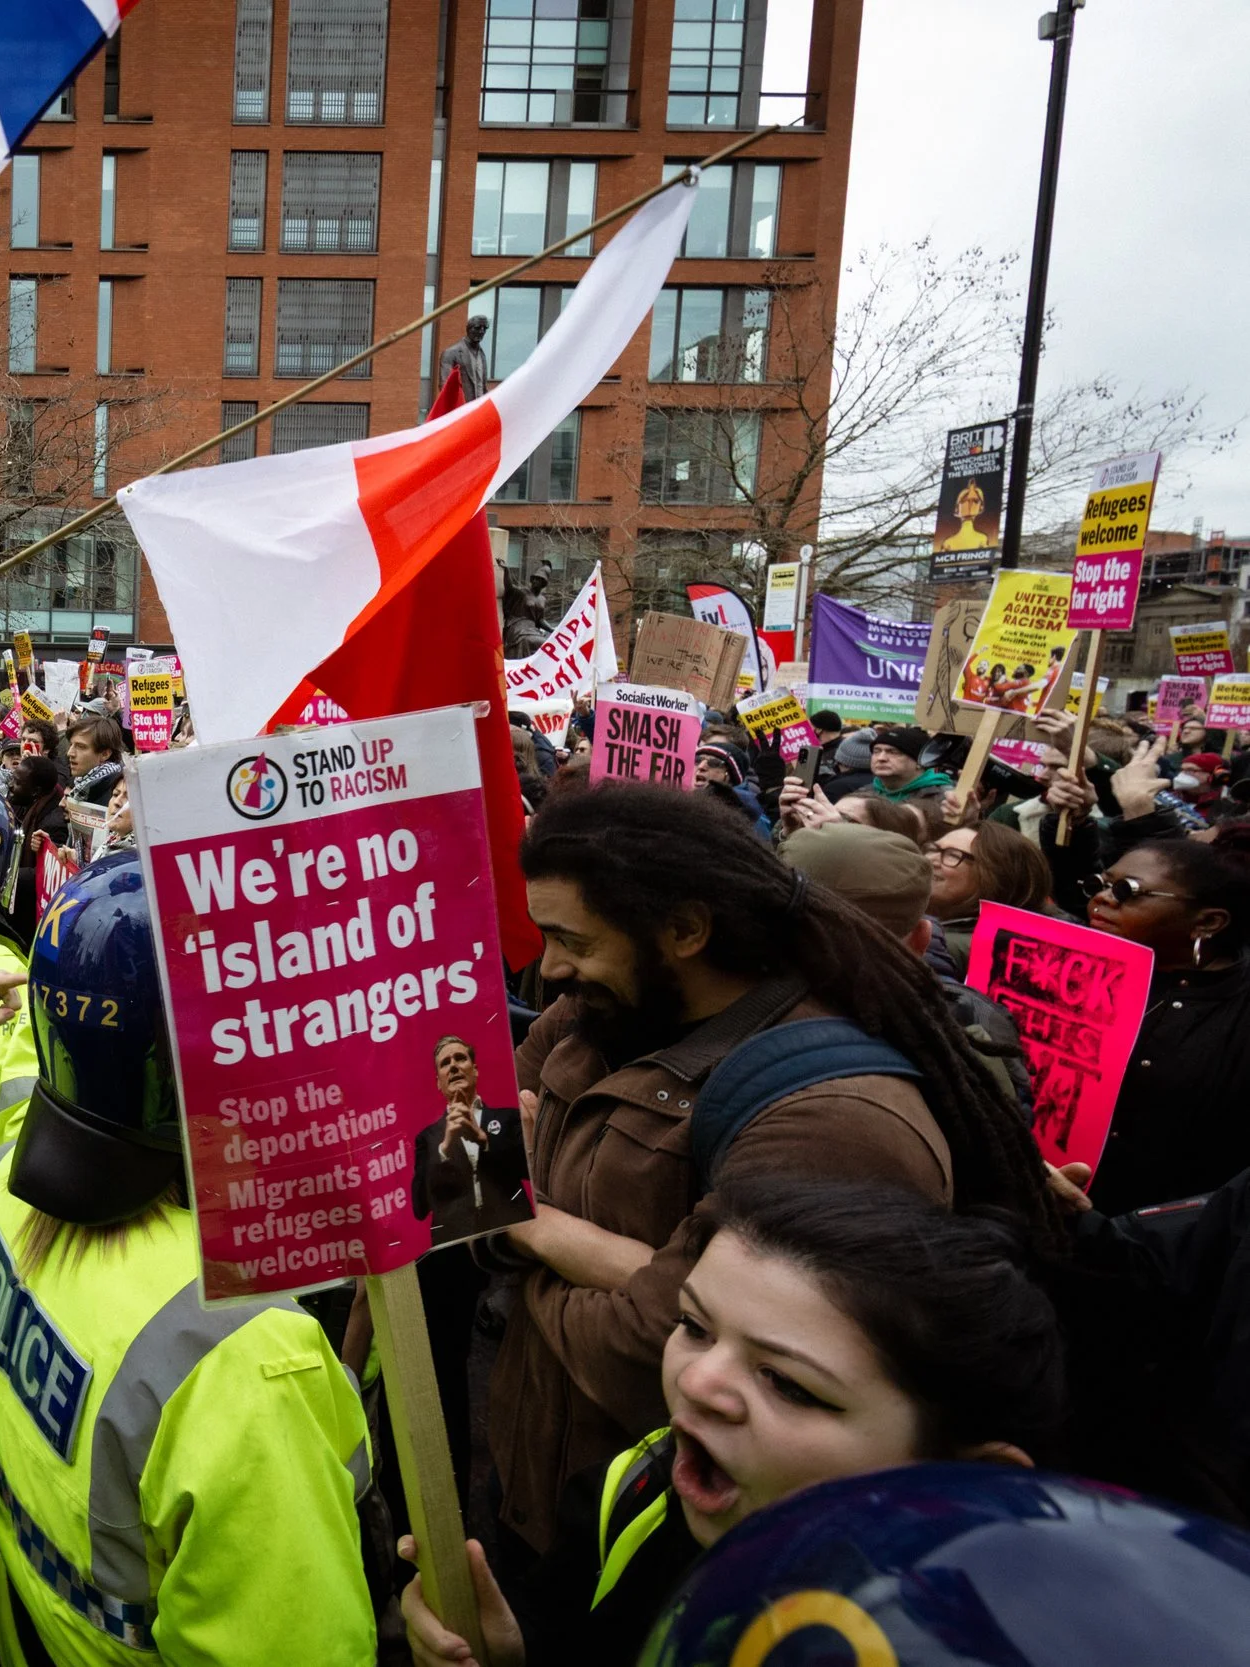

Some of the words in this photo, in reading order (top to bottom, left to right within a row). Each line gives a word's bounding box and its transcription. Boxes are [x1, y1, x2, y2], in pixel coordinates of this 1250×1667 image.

[950, 429, 983, 446] BRIT
[950, 452, 1000, 466] MANCHESTER
[953, 461, 996, 472] WELCOMES
[982, 464, 1001, 474] 2026
[1085, 494, 1146, 520] Refugees
[1080, 520, 1138, 547] welcome
[934, 553, 956, 563] MCR
[957, 550, 991, 561] FRINGE
[1075, 560, 1101, 587] Stop
[1103, 557, 1131, 581] the
[1014, 591, 1068, 607] UNITED
[1072, 587, 1088, 610] far
[1089, 585, 1126, 615] right
[1003, 603, 1068, 620] AGAINST
[1003, 614, 1063, 632] RACISM
[868, 633, 929, 648] UNIVE
[1174, 633, 1226, 644] Refugees
[1177, 643, 1223, 652] welcome
[1178, 655, 1204, 664] Stop
[1205, 653, 1224, 661] the
[1198, 661, 1226, 671] right
[131, 679, 169, 693] Refugees
[828, 689, 883, 699] EDUCATE
[1165, 682, 1200, 691] SMASH
[1165, 690, 1180, 698] THE
[1216, 684, 1250, 694] Refug
[23, 693, 51, 719] Refugees
[616, 689, 656, 707] Socialist
[656, 694, 689, 712] Worker
[843, 703, 877, 712] SOCIAL
[745, 700, 797, 724] Refugees
[1210, 714, 1228, 722] far
[1212, 704, 1239, 715] Stop
[133, 713, 152, 728] Stop
[153, 712, 167, 725] the
[752, 711, 801, 732] welcome
[135, 727, 148, 740] far
[148, 727, 168, 743] right
[606, 707, 681, 753] SMASH
[784, 726, 806, 739] the
[782, 737, 811, 754] right
[293, 745, 355, 780] STAND
[361, 738, 394, 764] UP
[605, 742, 643, 781] THE
[649, 751, 686, 787] FAR
[297, 780, 324, 808] TO
[330, 764, 408, 802] RACISM
[175, 838, 348, 915] We're
[357, 828, 419, 881] no
[387, 882, 436, 950] of
[218, 1090, 289, 1127] Stop
[294, 1080, 342, 1113] the
[223, 1100, 397, 1164] deportations
[228, 1165, 362, 1211] Migrants
[368, 1139, 407, 1182] and
[233, 1202, 363, 1246] refugees
[370, 1187, 407, 1220] are
[237, 1235, 366, 1281] welcome
